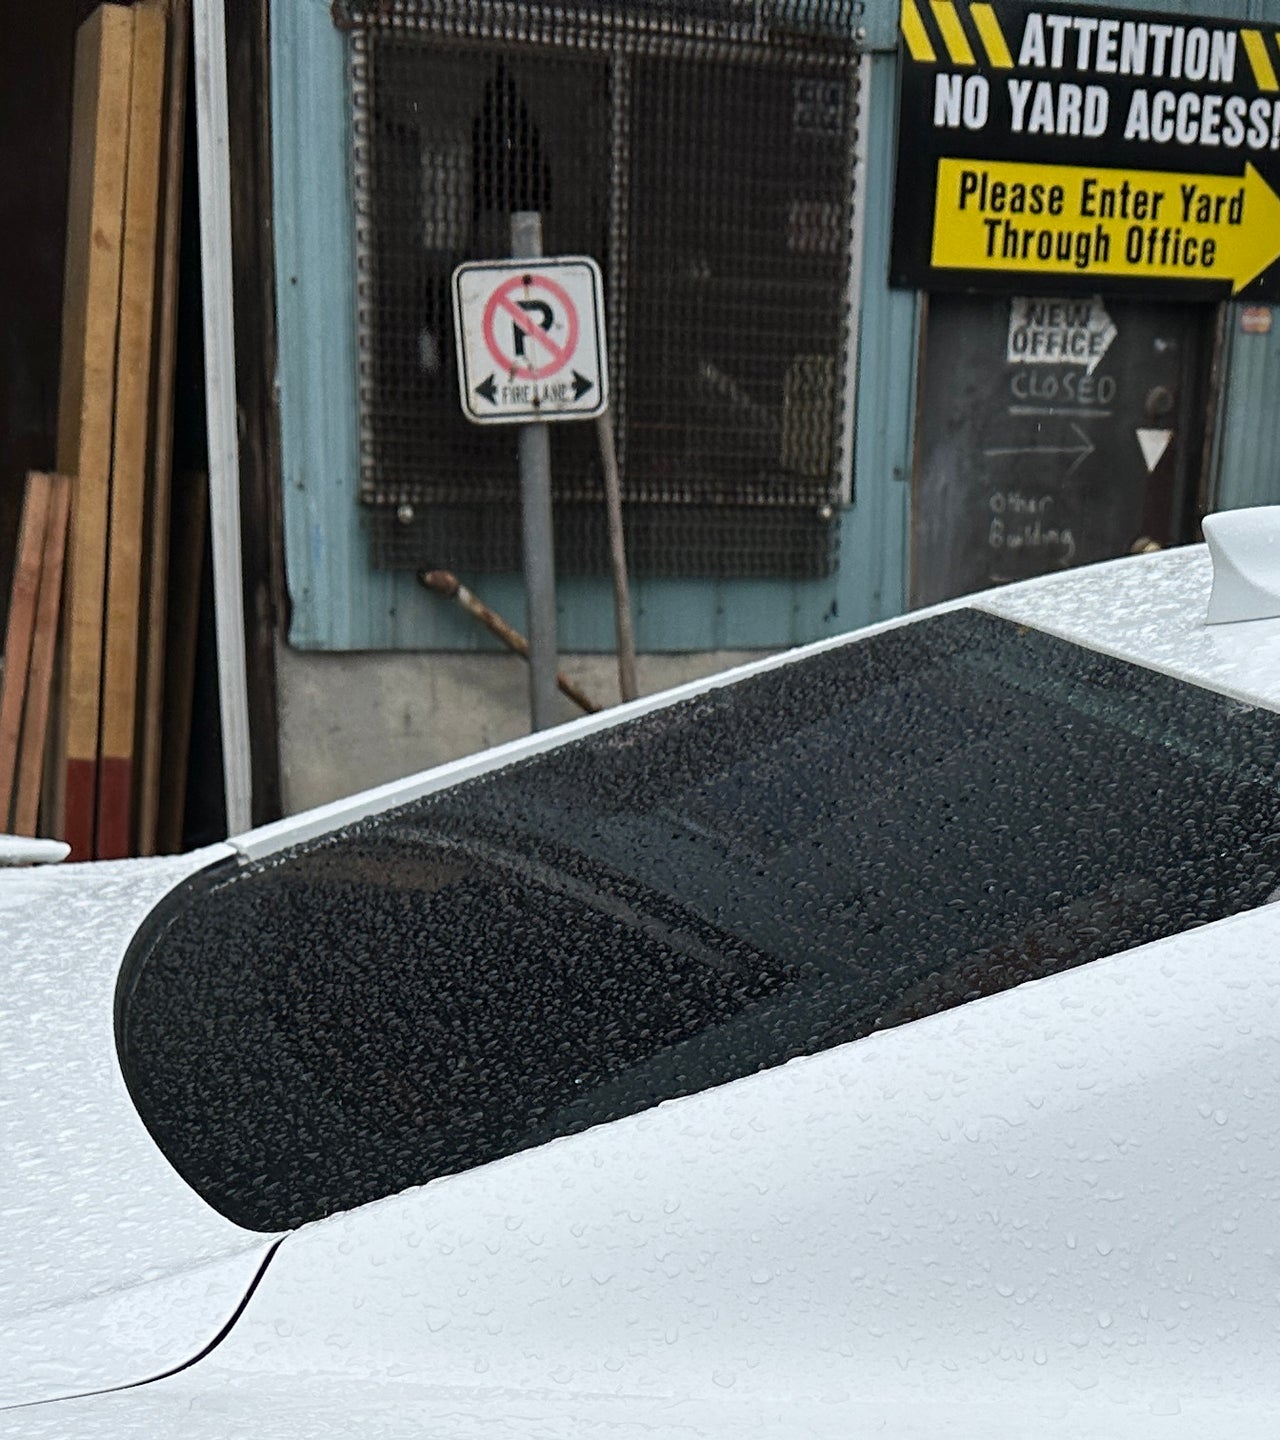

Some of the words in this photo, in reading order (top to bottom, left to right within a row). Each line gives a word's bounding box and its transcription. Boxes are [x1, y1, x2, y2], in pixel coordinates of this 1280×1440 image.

[1018, 12, 1237, 83] ATTENTION
[933, 72, 990, 130] NO
[1007, 77, 1110, 138] YARD
[959, 170, 1064, 216] Please
[1080, 178, 1164, 220] Enter
[1181, 183, 1245, 225] Yard
[984, 218, 1110, 269] Through
[1126, 225, 1216, 268] Office
[1025, 302, 1089, 328] NEW
[1012, 328, 1104, 356] OFFICE
[1011, 370, 1116, 403] CLOSED
